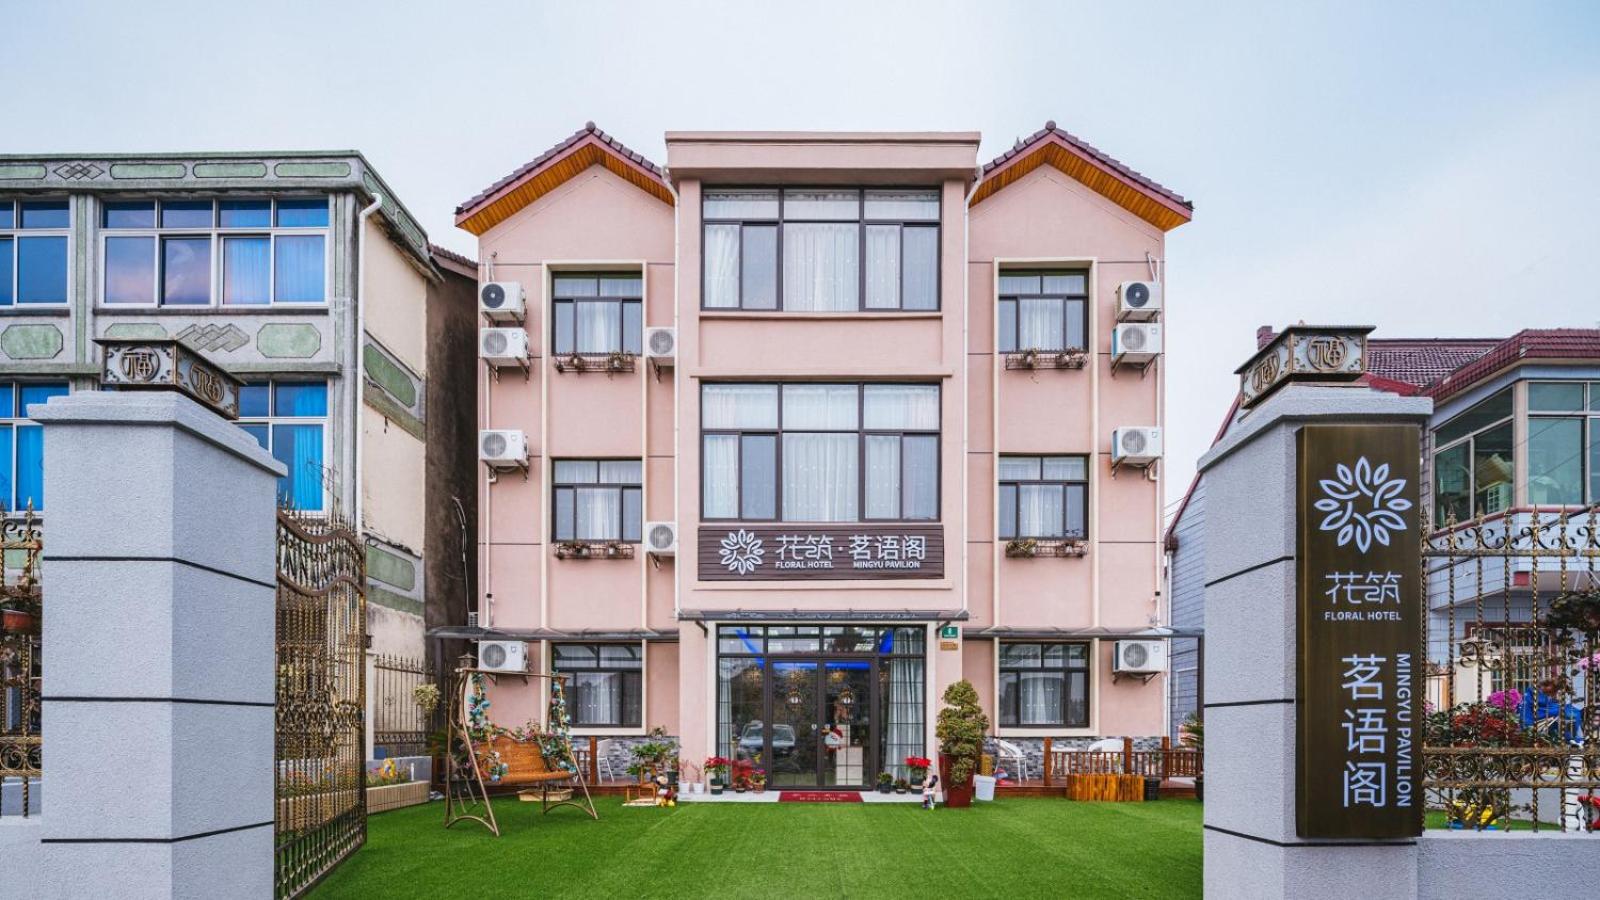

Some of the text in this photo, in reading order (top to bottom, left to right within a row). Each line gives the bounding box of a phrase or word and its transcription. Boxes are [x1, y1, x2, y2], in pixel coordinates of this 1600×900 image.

[775, 561, 834, 569] FLORAL HOTEL
[853, 561, 920, 569] MINGYU PAVILION
[1325, 570, 1402, 604] 花筑
[1324, 611, 1402, 621] FLORAL HOTEL
[1341, 653, 1388, 807] 茗语阁
[1396, 653, 1412, 807] MINGYU PAVILION
